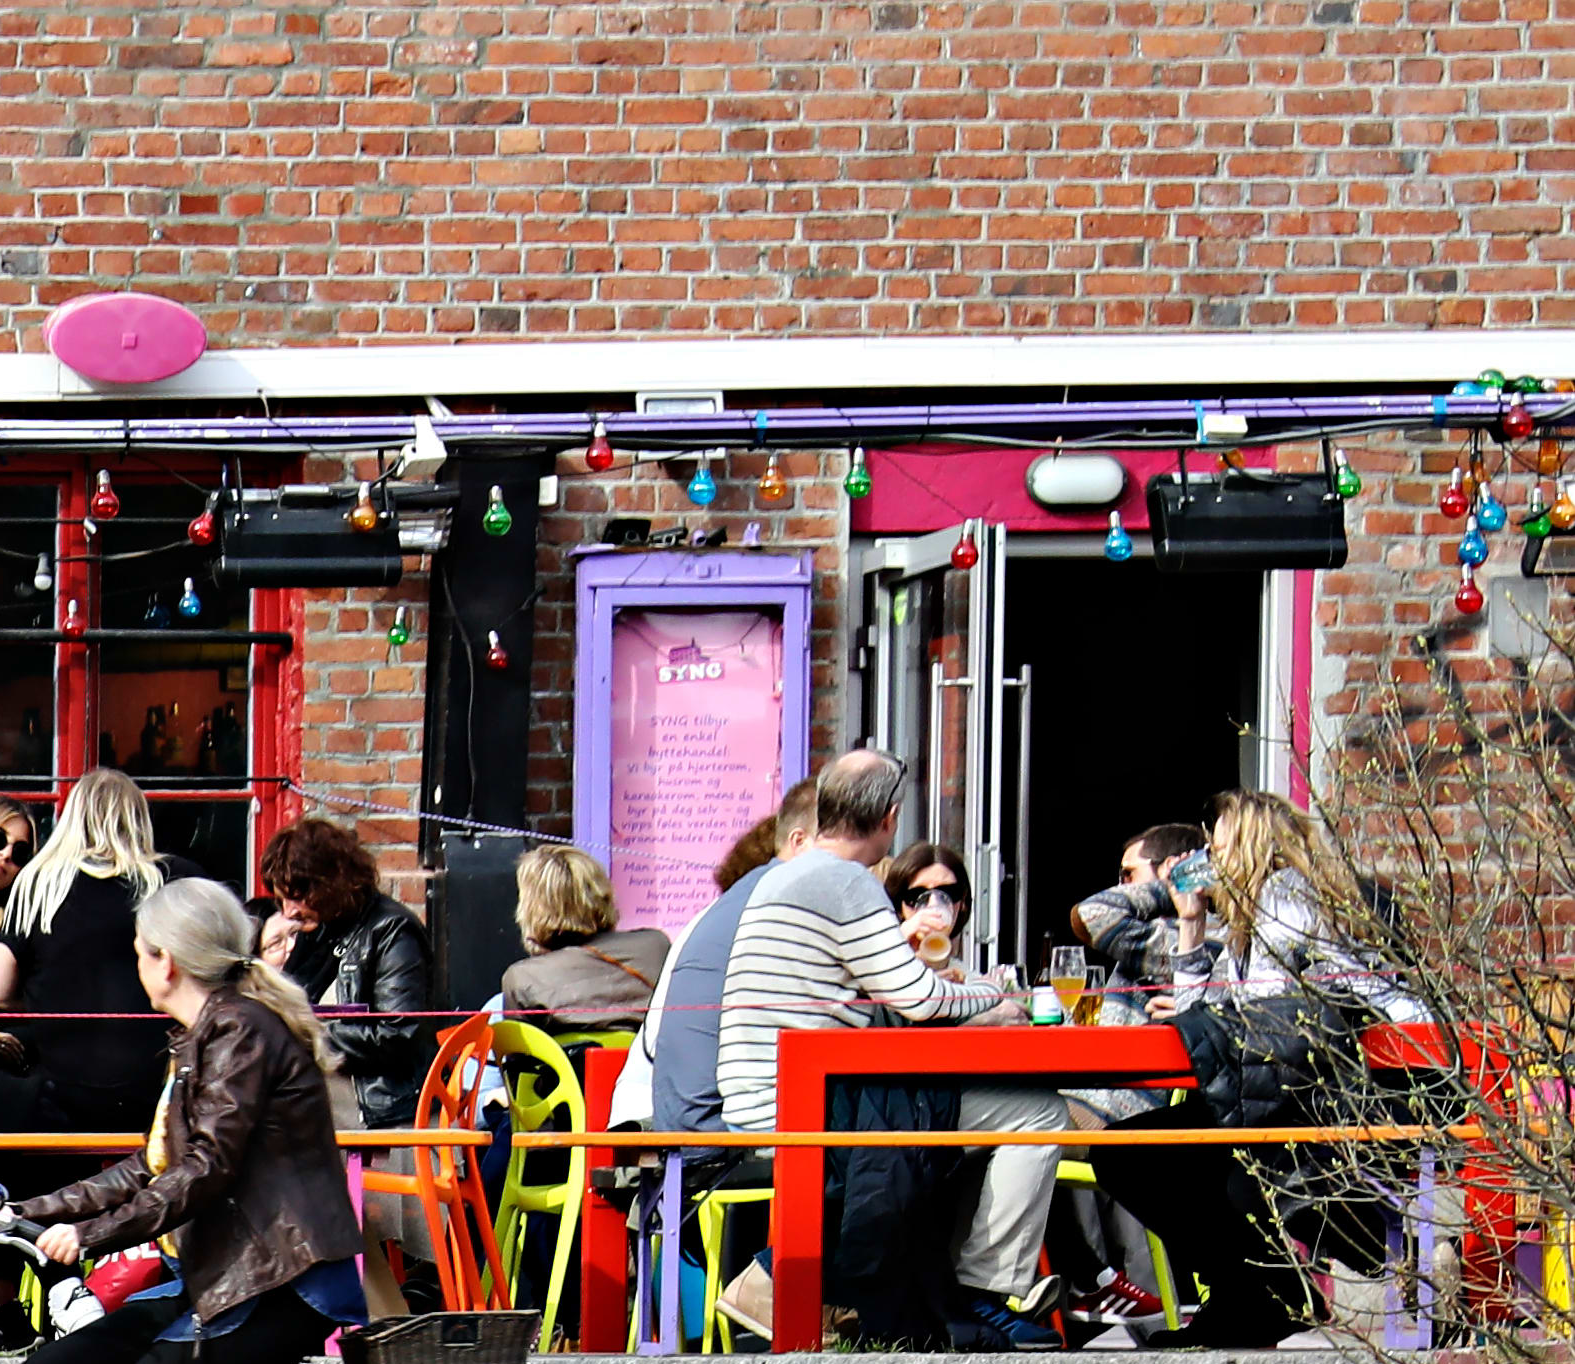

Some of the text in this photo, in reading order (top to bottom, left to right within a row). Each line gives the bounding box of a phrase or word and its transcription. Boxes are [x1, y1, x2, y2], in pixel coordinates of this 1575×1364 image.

[658, 662, 722, 683] SYNG
[650, 714, 729, 731] SYNG tilbyr
[662, 731, 717, 742] en enkel
[643, 763, 662, 777] byr
[668, 762, 683, 775] på
[739, 789, 754, 800] du
